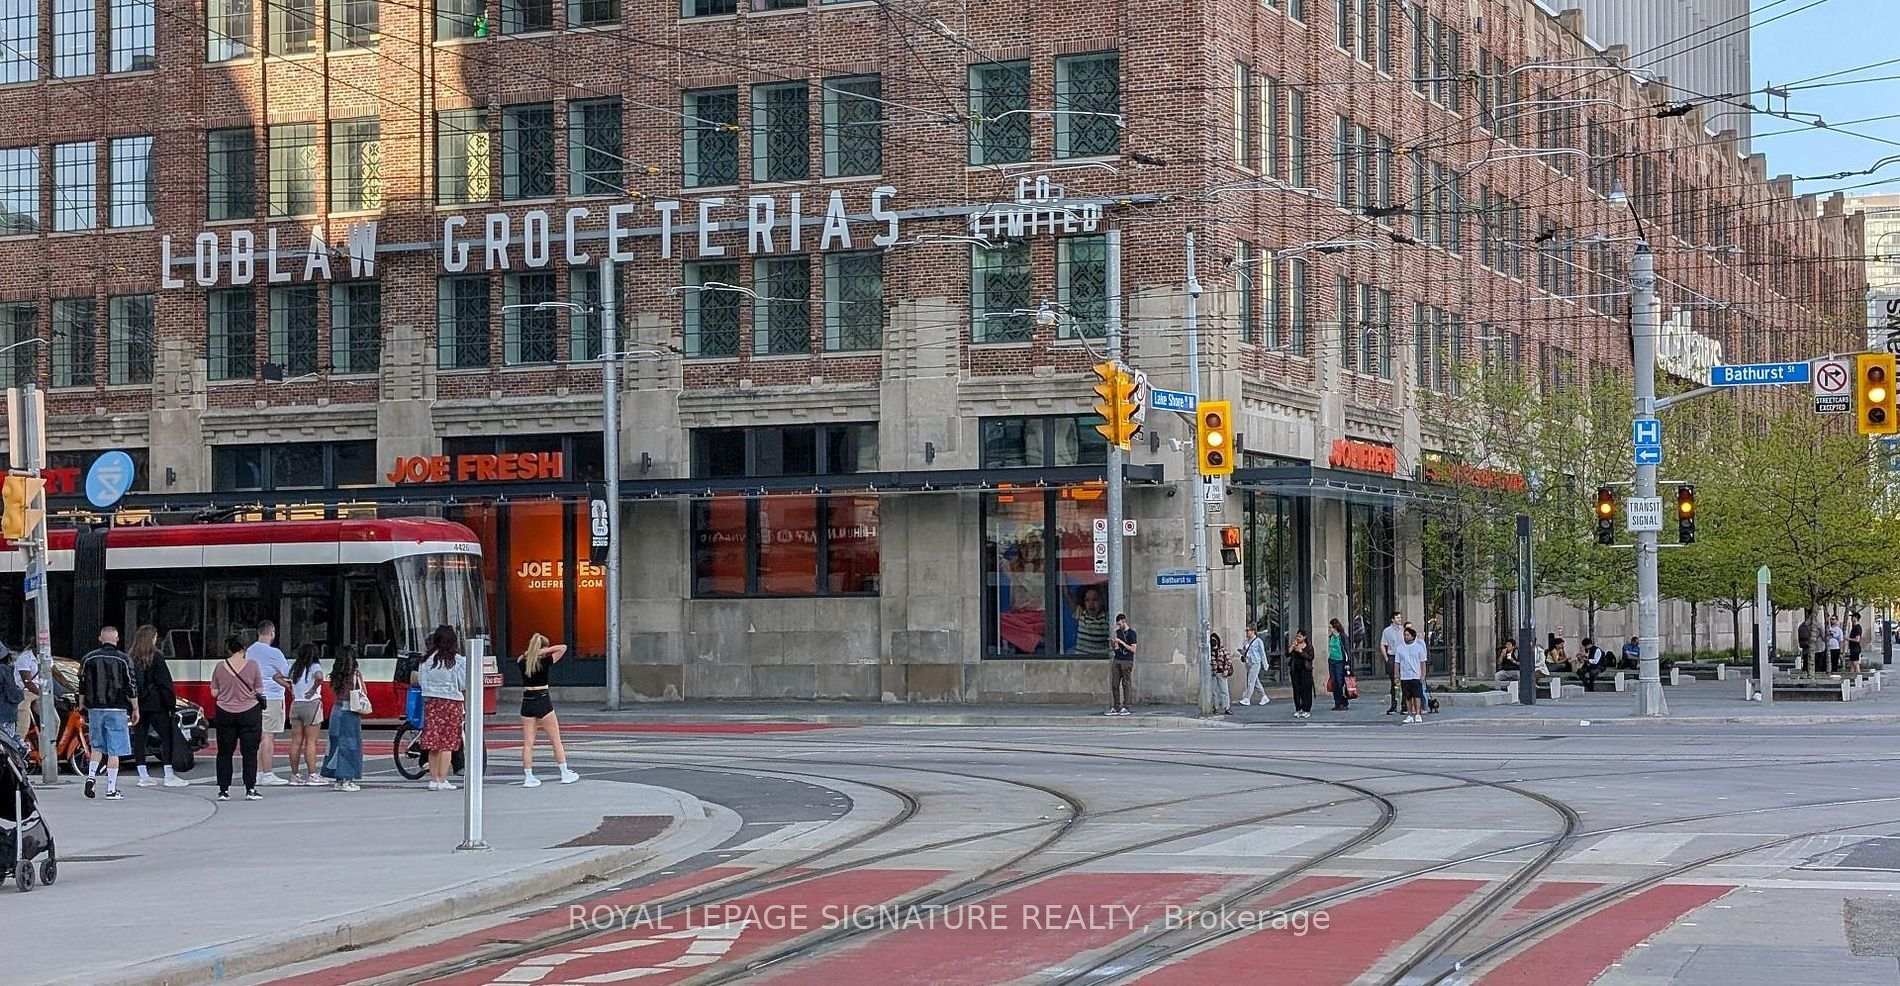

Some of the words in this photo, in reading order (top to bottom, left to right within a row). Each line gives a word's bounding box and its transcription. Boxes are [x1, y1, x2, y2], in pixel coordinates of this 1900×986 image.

[971, 203, 1101, 238] LIMITED
[162, 221, 378, 289] LOBLAW
[443, 186, 899, 273] GROCETERIAS
[1725, 365, 1784, 382] Bathurst
[1787, 365, 1795, 374] St
[1154, 392, 1167, 405] Lake
[1168, 393, 1184, 408] Shore
[1816, 396, 1849, 404] STREETCARS
[1819, 403, 1847, 412] EXCEPTED
[1637, 423, 1656, 442] H
[387, 456, 450, 483] JOE
[457, 453, 564, 481] FRESH
[1630, 502, 1660, 512] TRANSIT
[1632, 515, 1659, 525] SIGNAL
[517, 561, 552, 577] JOE
[528, 580, 603, 588] JOEFRE.COM
[1161, 575, 1185, 584] Bathurst
